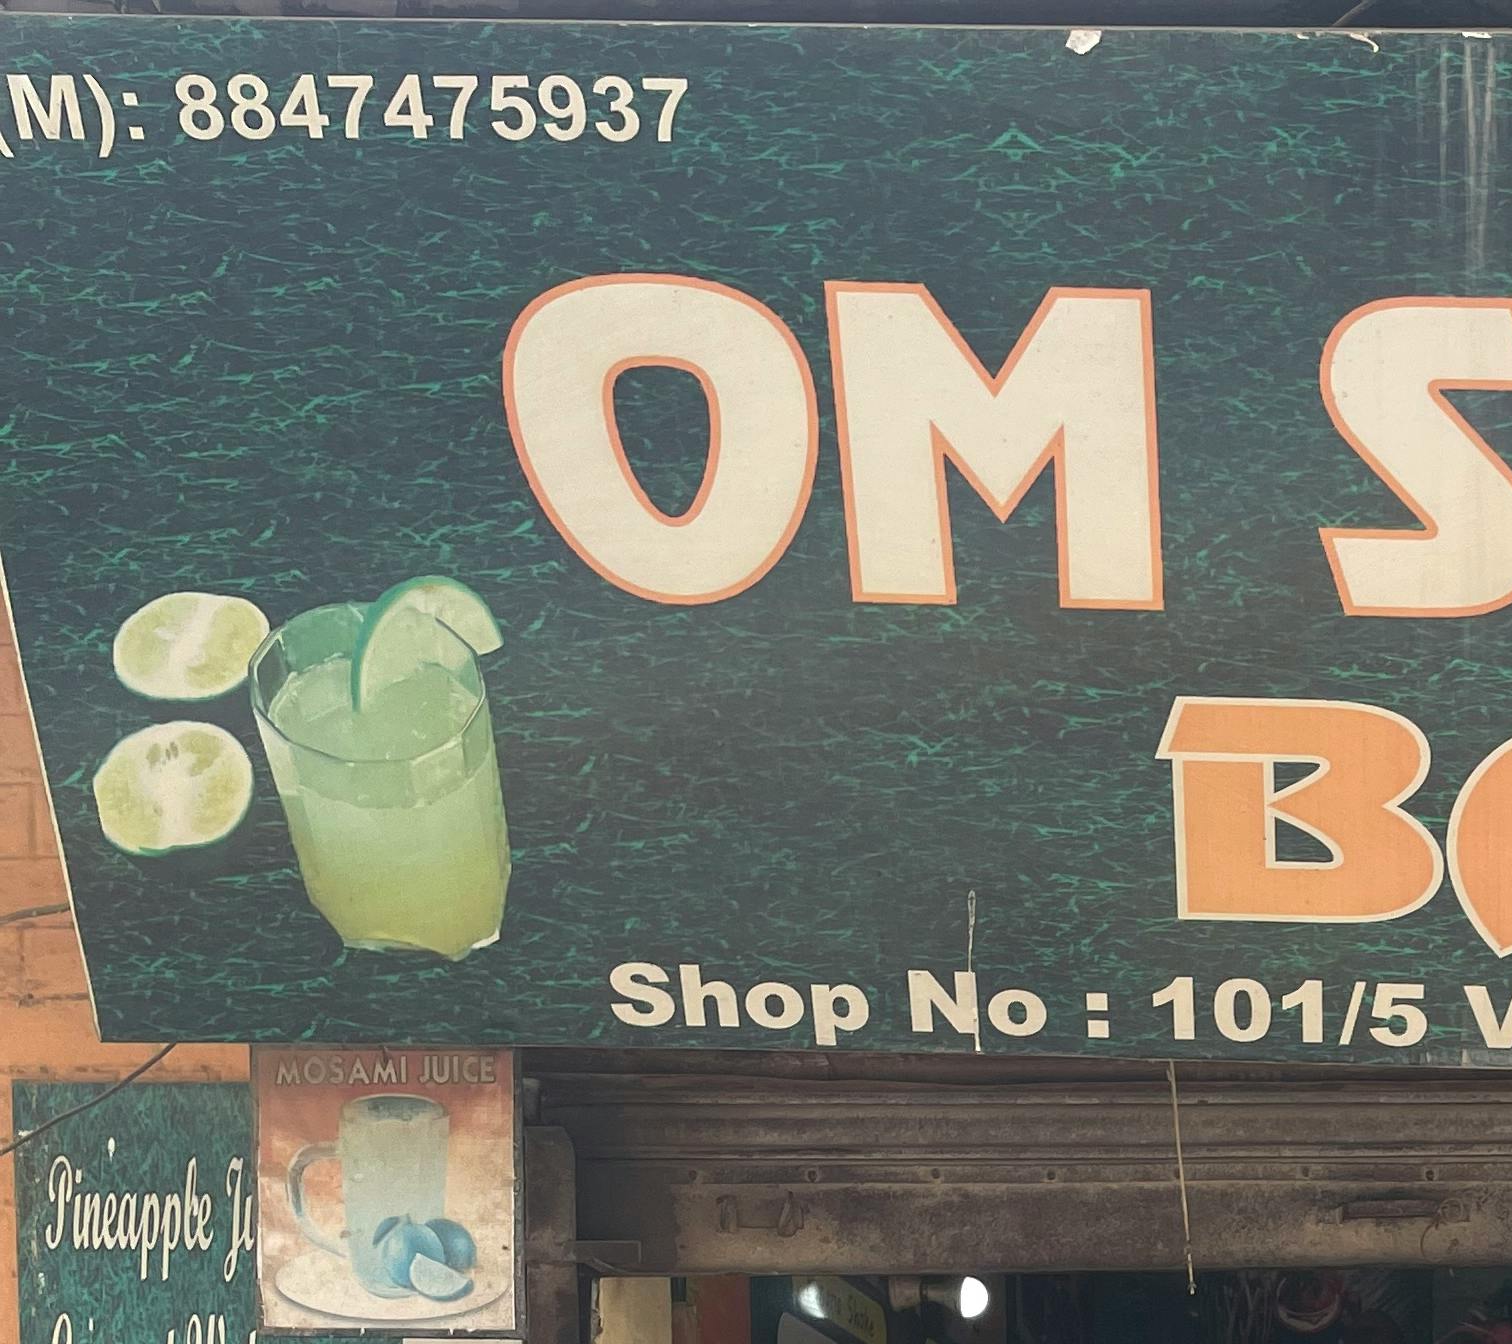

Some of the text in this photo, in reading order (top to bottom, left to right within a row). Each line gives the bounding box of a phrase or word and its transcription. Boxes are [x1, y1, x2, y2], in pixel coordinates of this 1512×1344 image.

[175, 73, 688, 144] 8847475937
[502, 272, 1163, 610] OM
[609, 961, 869, 1046] Shop
[909, 970, 1046, 1038] No
[1150, 976, 1426, 1047] 101/5
[276, 1054, 496, 1085] MOSAMI JUICE
[45, 1155, 213, 1281] Pineapple
